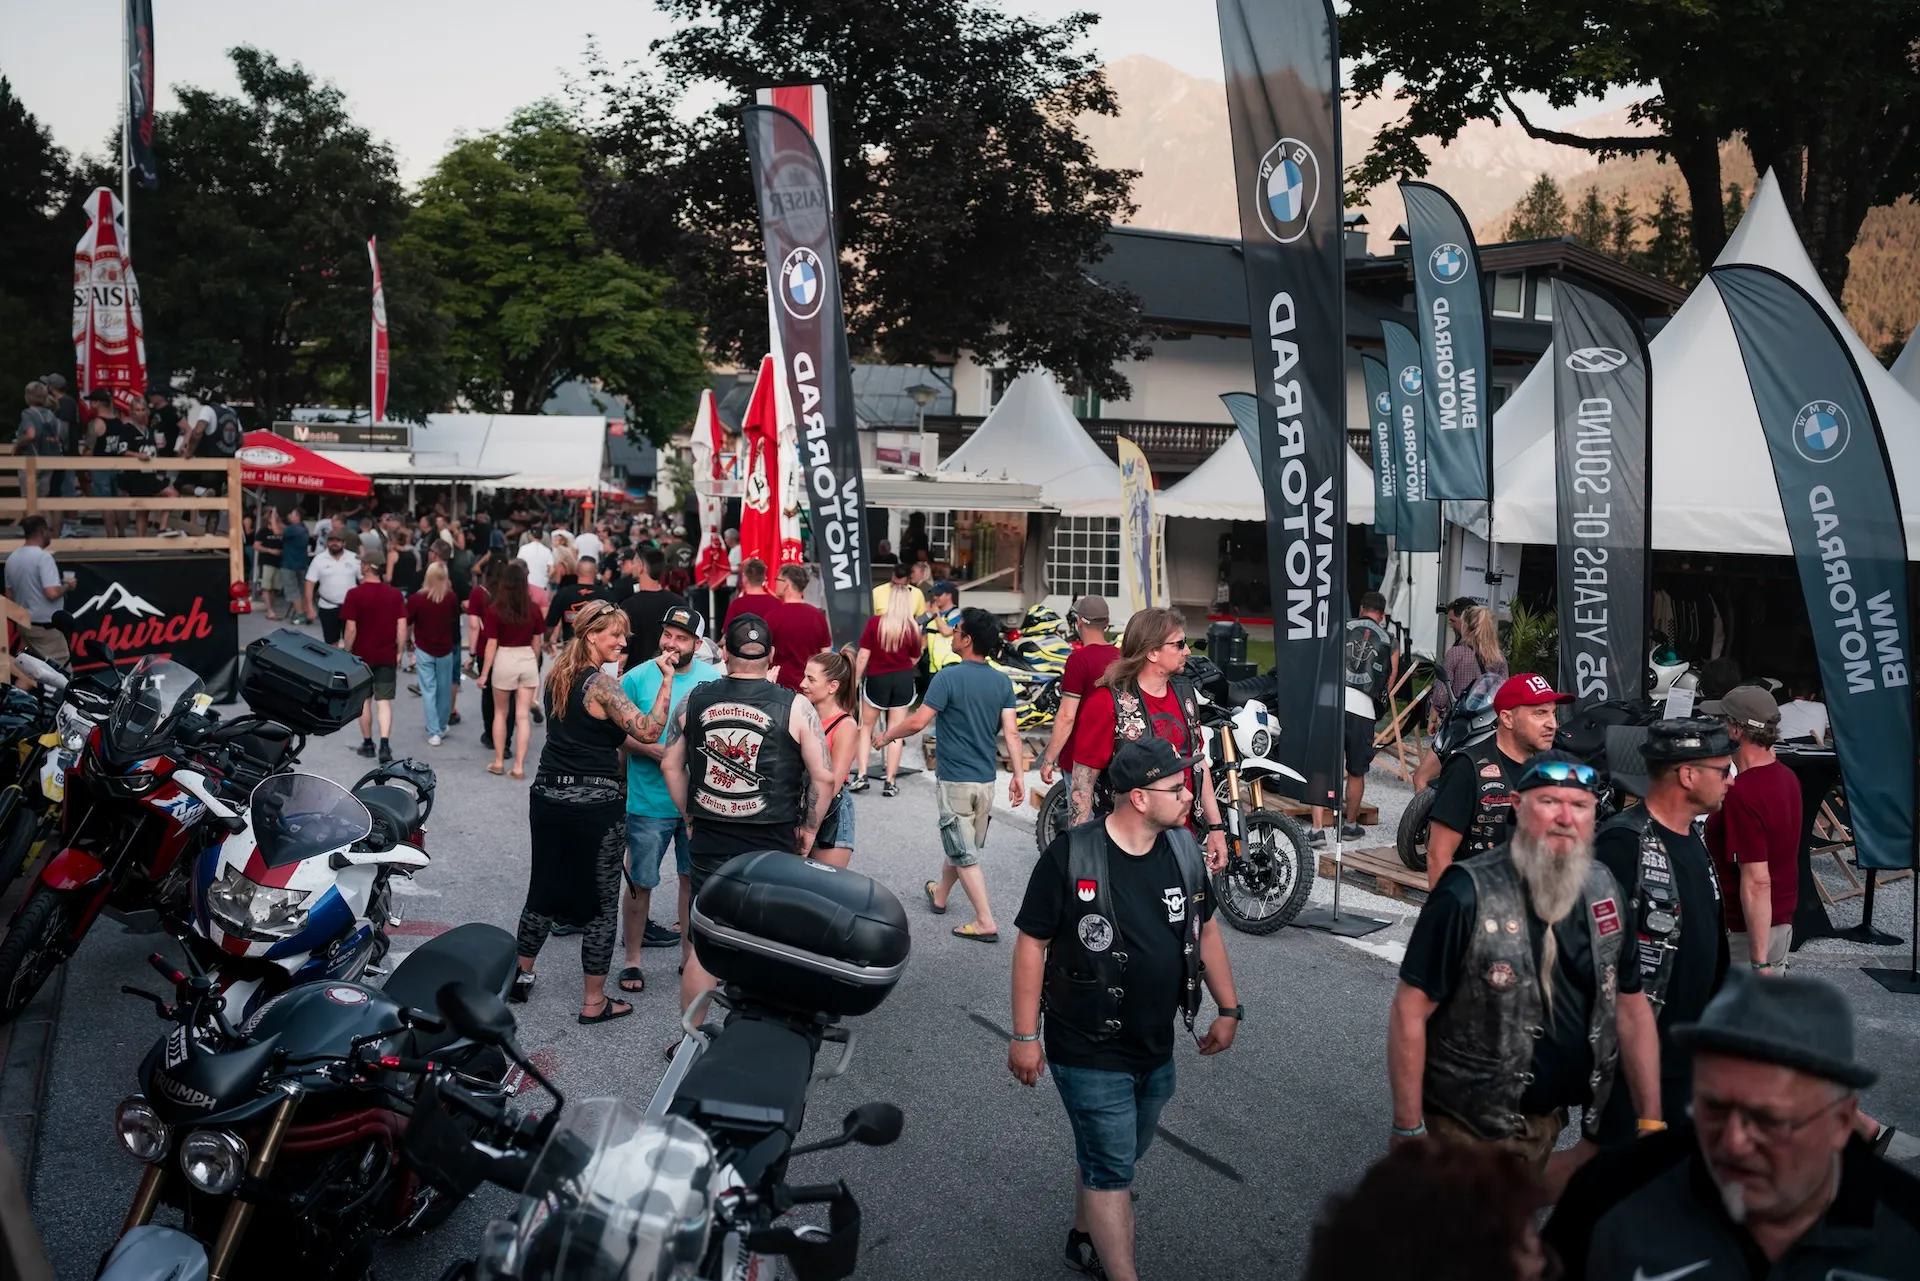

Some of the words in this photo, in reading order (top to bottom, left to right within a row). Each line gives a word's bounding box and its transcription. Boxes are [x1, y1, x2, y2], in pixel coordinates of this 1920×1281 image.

[264, 470, 281, 483] bist
[282, 473, 297, 485] ein
[298, 474, 325, 488] Kaiser
[70, 596, 213, 658] church
[707, 706, 765, 724] Motorfriends
[700, 794, 727, 814] Flying
[730, 800, 758, 814] Devils
[152, 1068, 218, 1112] TRIUMPH
